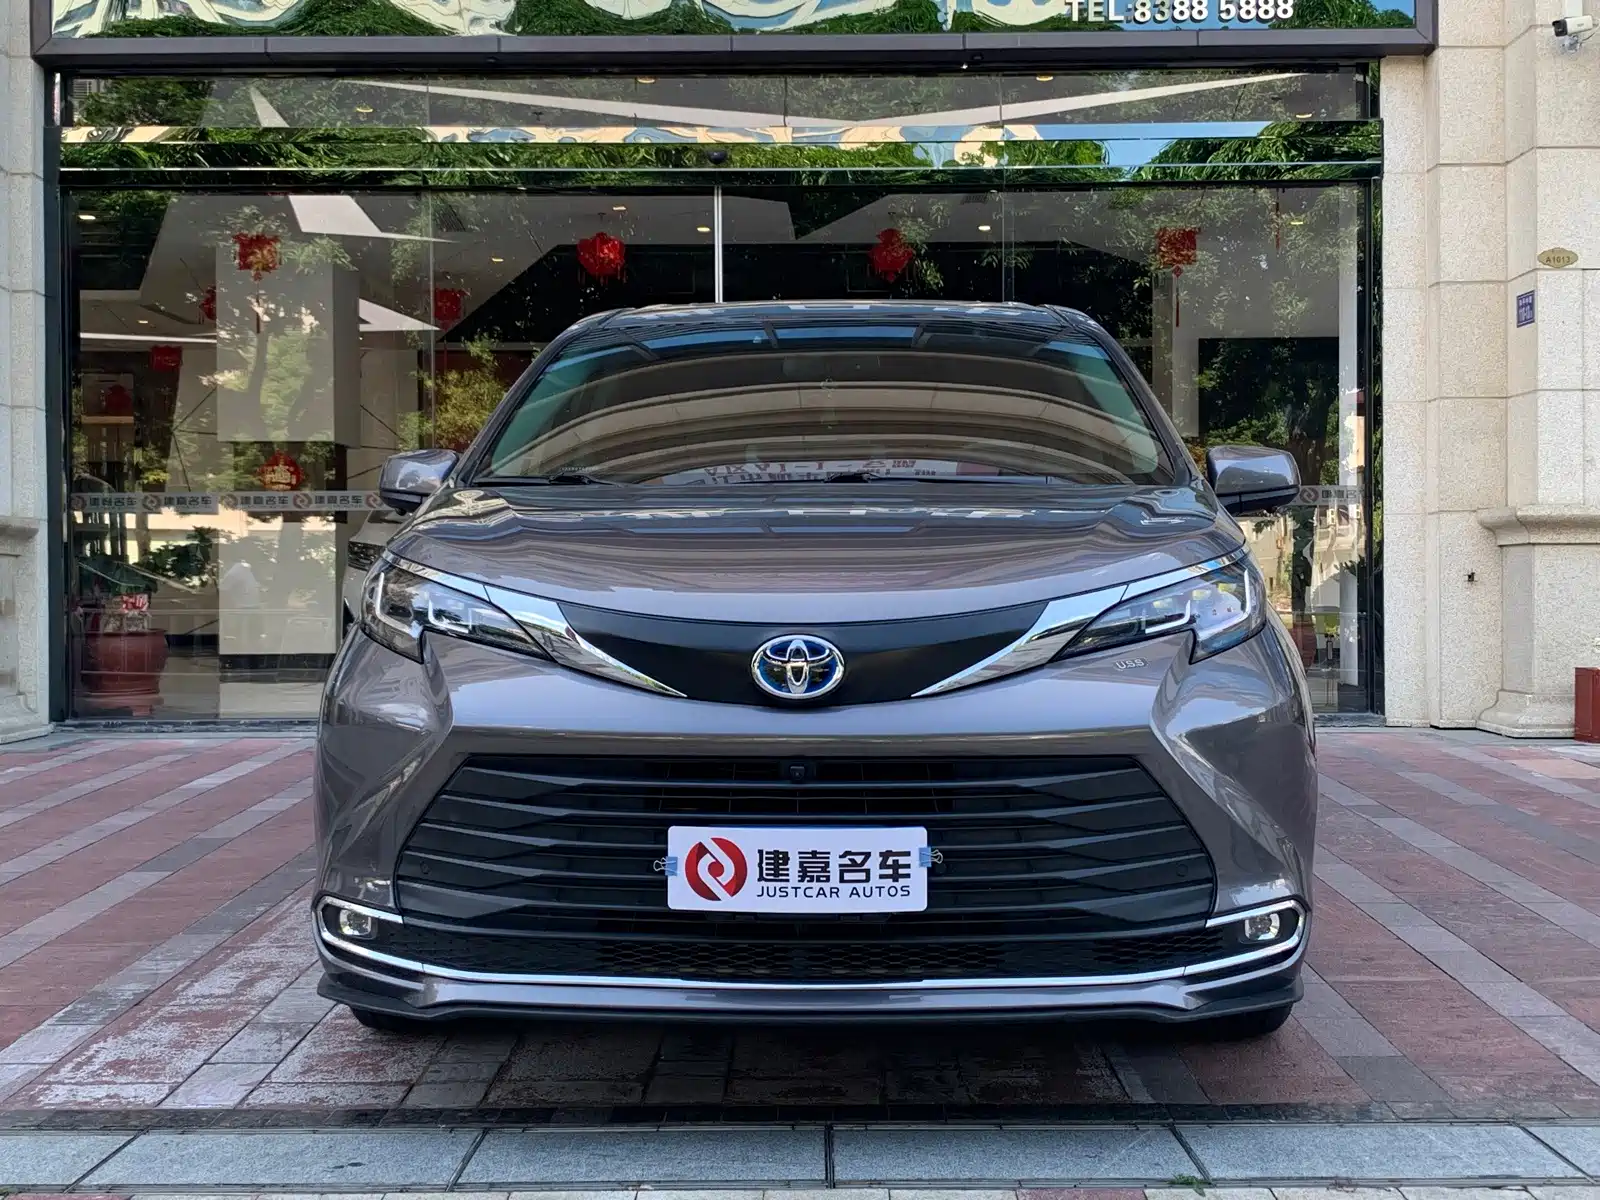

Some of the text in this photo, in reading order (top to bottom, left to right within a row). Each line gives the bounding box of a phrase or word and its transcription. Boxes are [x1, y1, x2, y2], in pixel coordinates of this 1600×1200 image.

[1218, 0, 1294, 20] 5888
[1545, 255, 1571, 264] A1013
[1115, 658, 1145, 670] USS
[757, 848, 912, 884] 建嘉名车
[757, 885, 911, 898] JUSTCAR AUTOS
